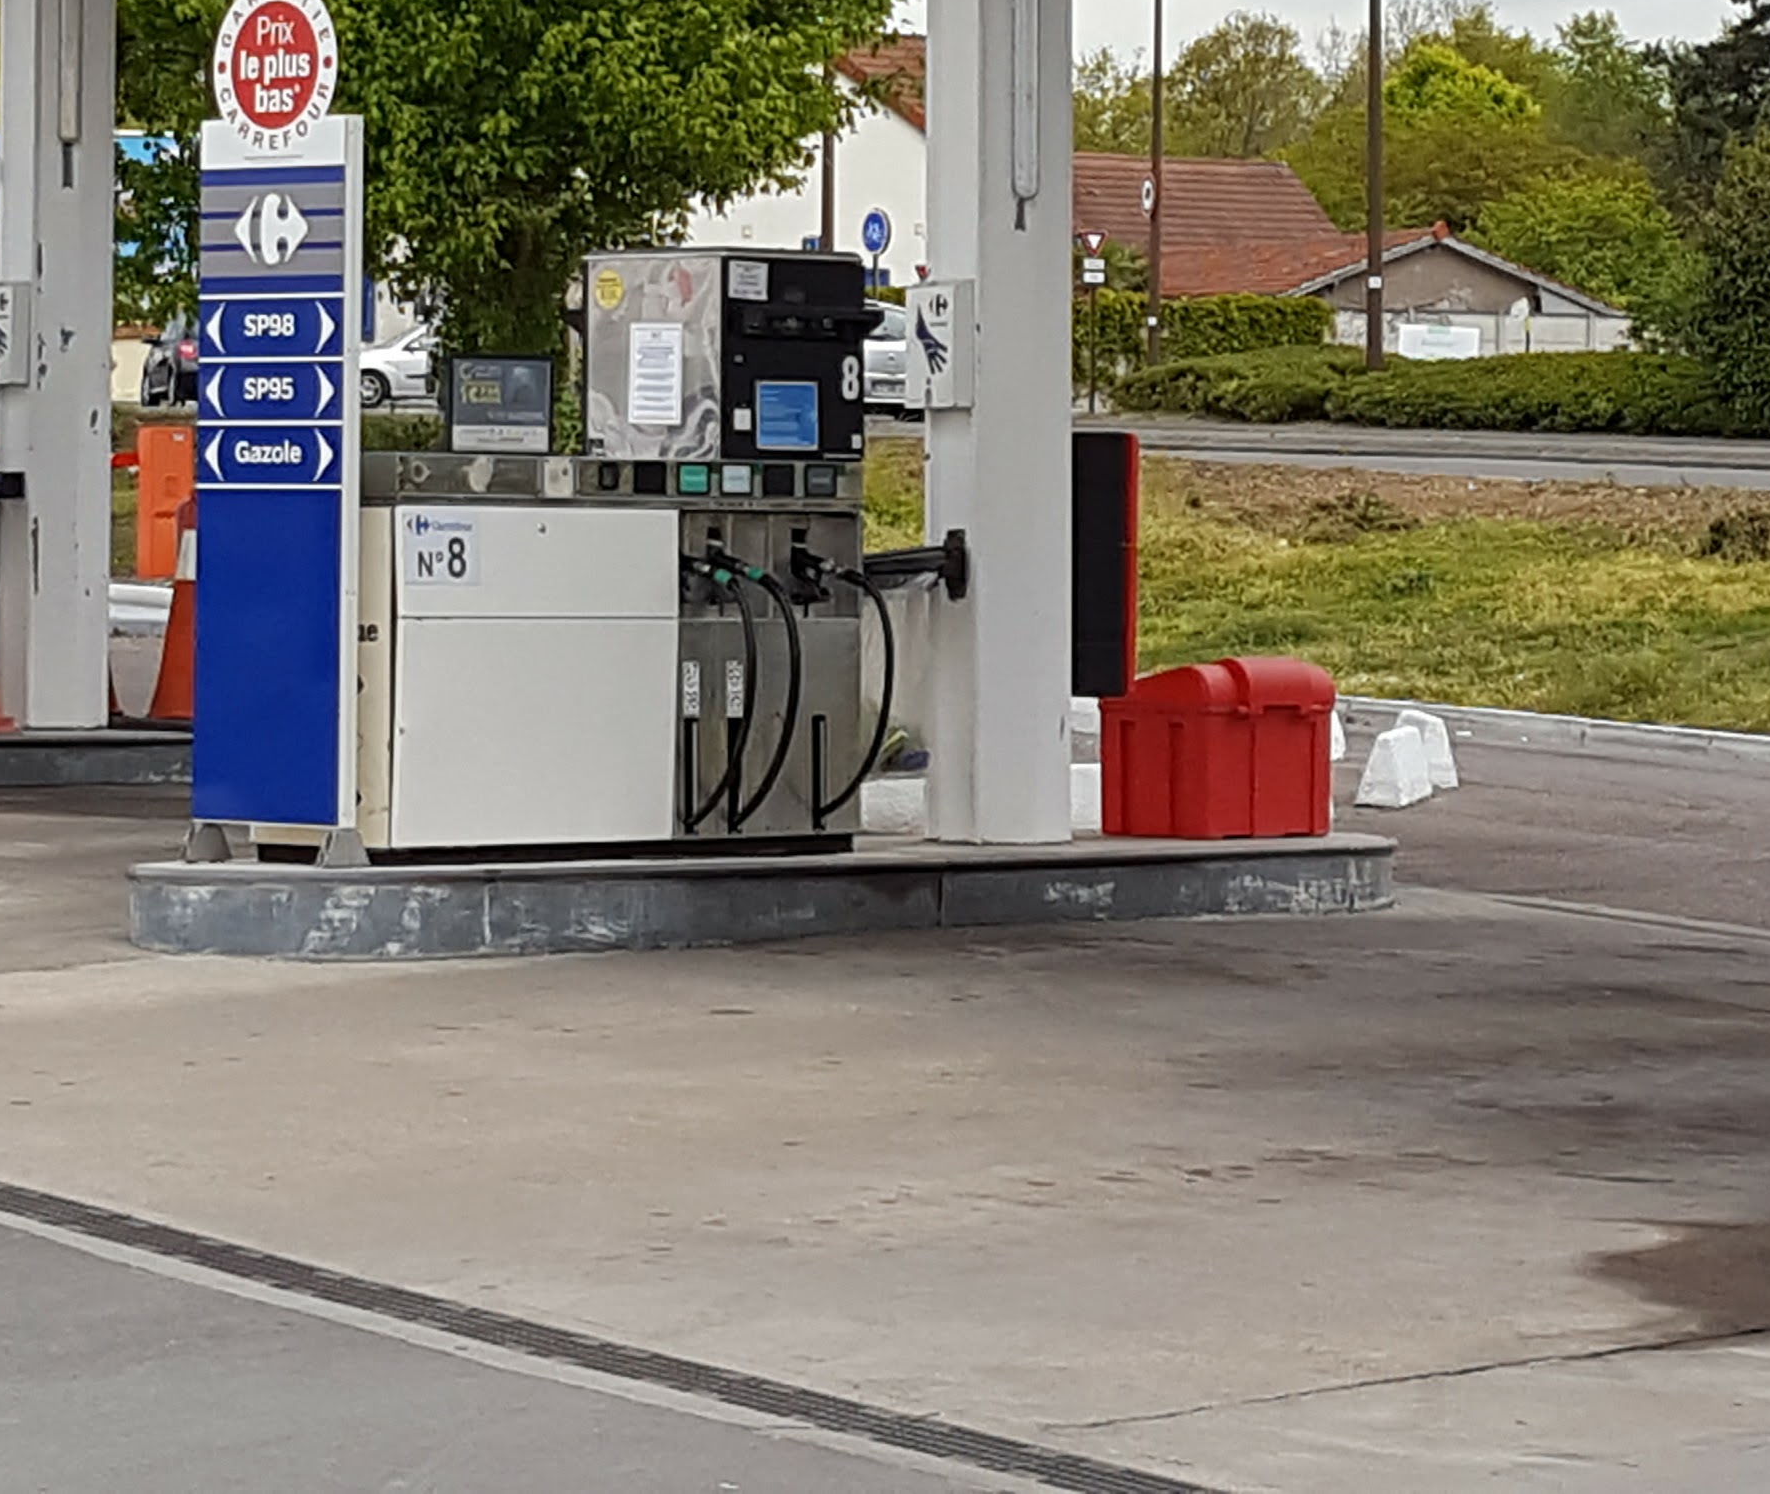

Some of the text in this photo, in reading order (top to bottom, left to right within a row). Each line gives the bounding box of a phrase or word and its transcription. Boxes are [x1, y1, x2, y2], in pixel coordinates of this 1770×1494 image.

[256, 15, 295, 46] Prix
[240, 47, 311, 86] le plus
[220, 83, 329, 150] CARREFOUR
[243, 313, 295, 337] SP98
[242, 377, 295, 401] SP95
[841, 355, 860, 401] 8
[234, 438, 303, 465] Gazole
